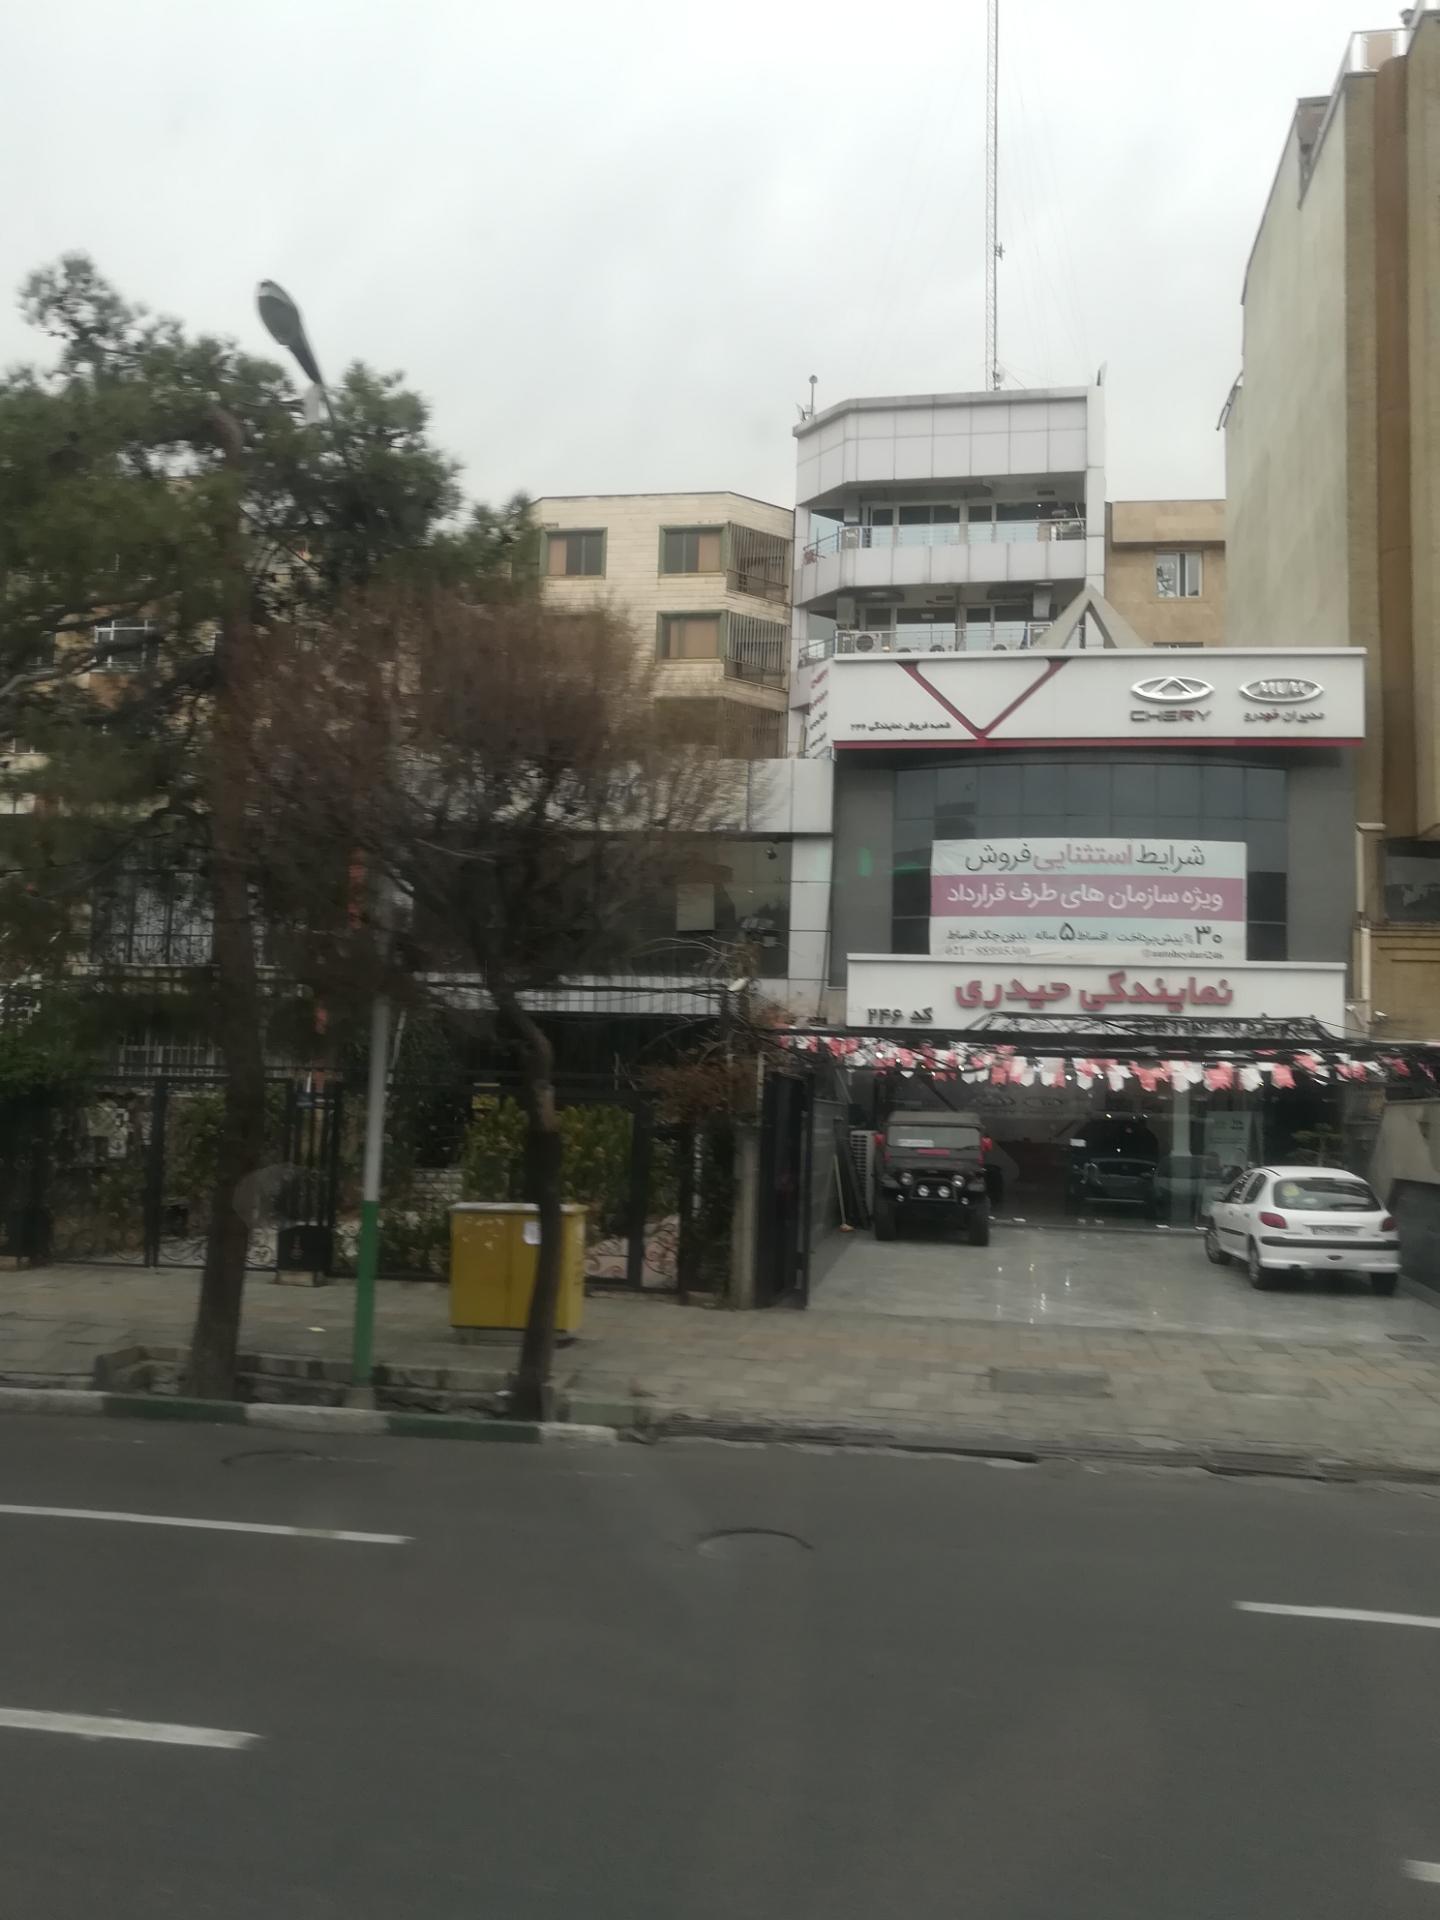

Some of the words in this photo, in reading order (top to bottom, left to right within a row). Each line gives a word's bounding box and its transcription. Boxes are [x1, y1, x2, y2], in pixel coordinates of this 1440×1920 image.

[1130, 710, 1212, 723] CHERY
[965, 843, 1032, 872] فروش
[1032, 844, 1133, 871] استثنایی
[1135, 845, 1206, 873] شرایط
[947, 882, 1006, 908] قرارداد
[1008, 882, 1058, 908] طرف
[1060, 884, 1105, 909] های
[1107, 884, 1180, 910] سازمان
[1181, 888, 1224, 911] ویژه
[954, 978, 1071, 1009] حیدری
[1079, 971, 1233, 1012] نمایندگی
[867, 1007, 903, 1025] ۲۴۶
[910, 1007, 933, 1024] کد
